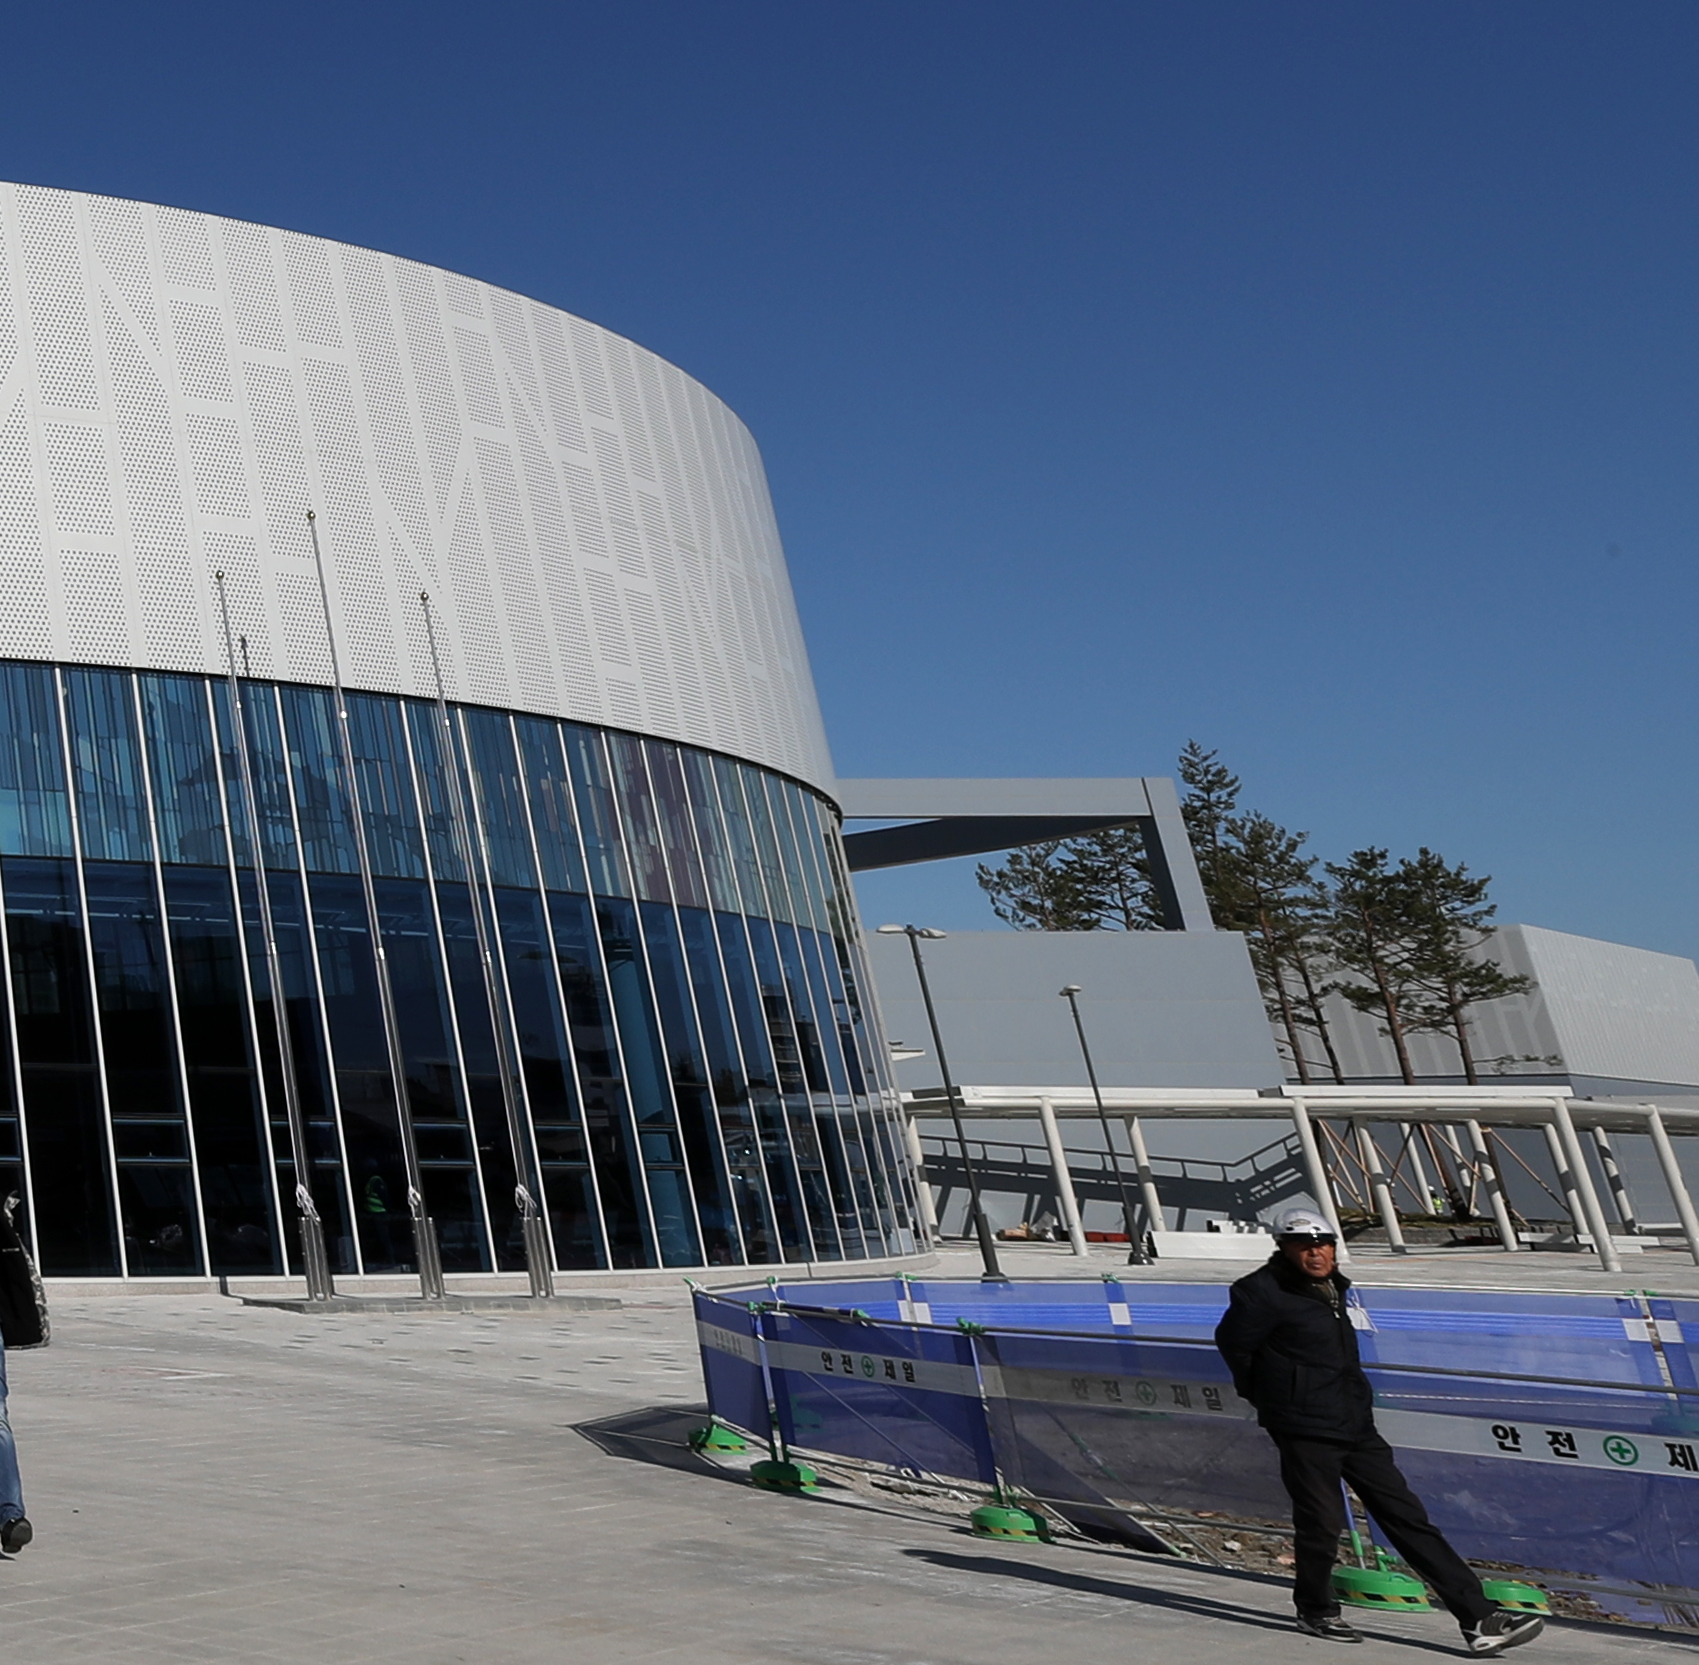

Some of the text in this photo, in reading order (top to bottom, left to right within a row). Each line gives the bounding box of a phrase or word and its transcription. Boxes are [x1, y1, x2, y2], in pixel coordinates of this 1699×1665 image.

[822, 1351, 916, 1383] 안전 제일
[1071, 1378, 1223, 1411] 안전 제일
[1491, 1424, 1579, 1459] 안전
